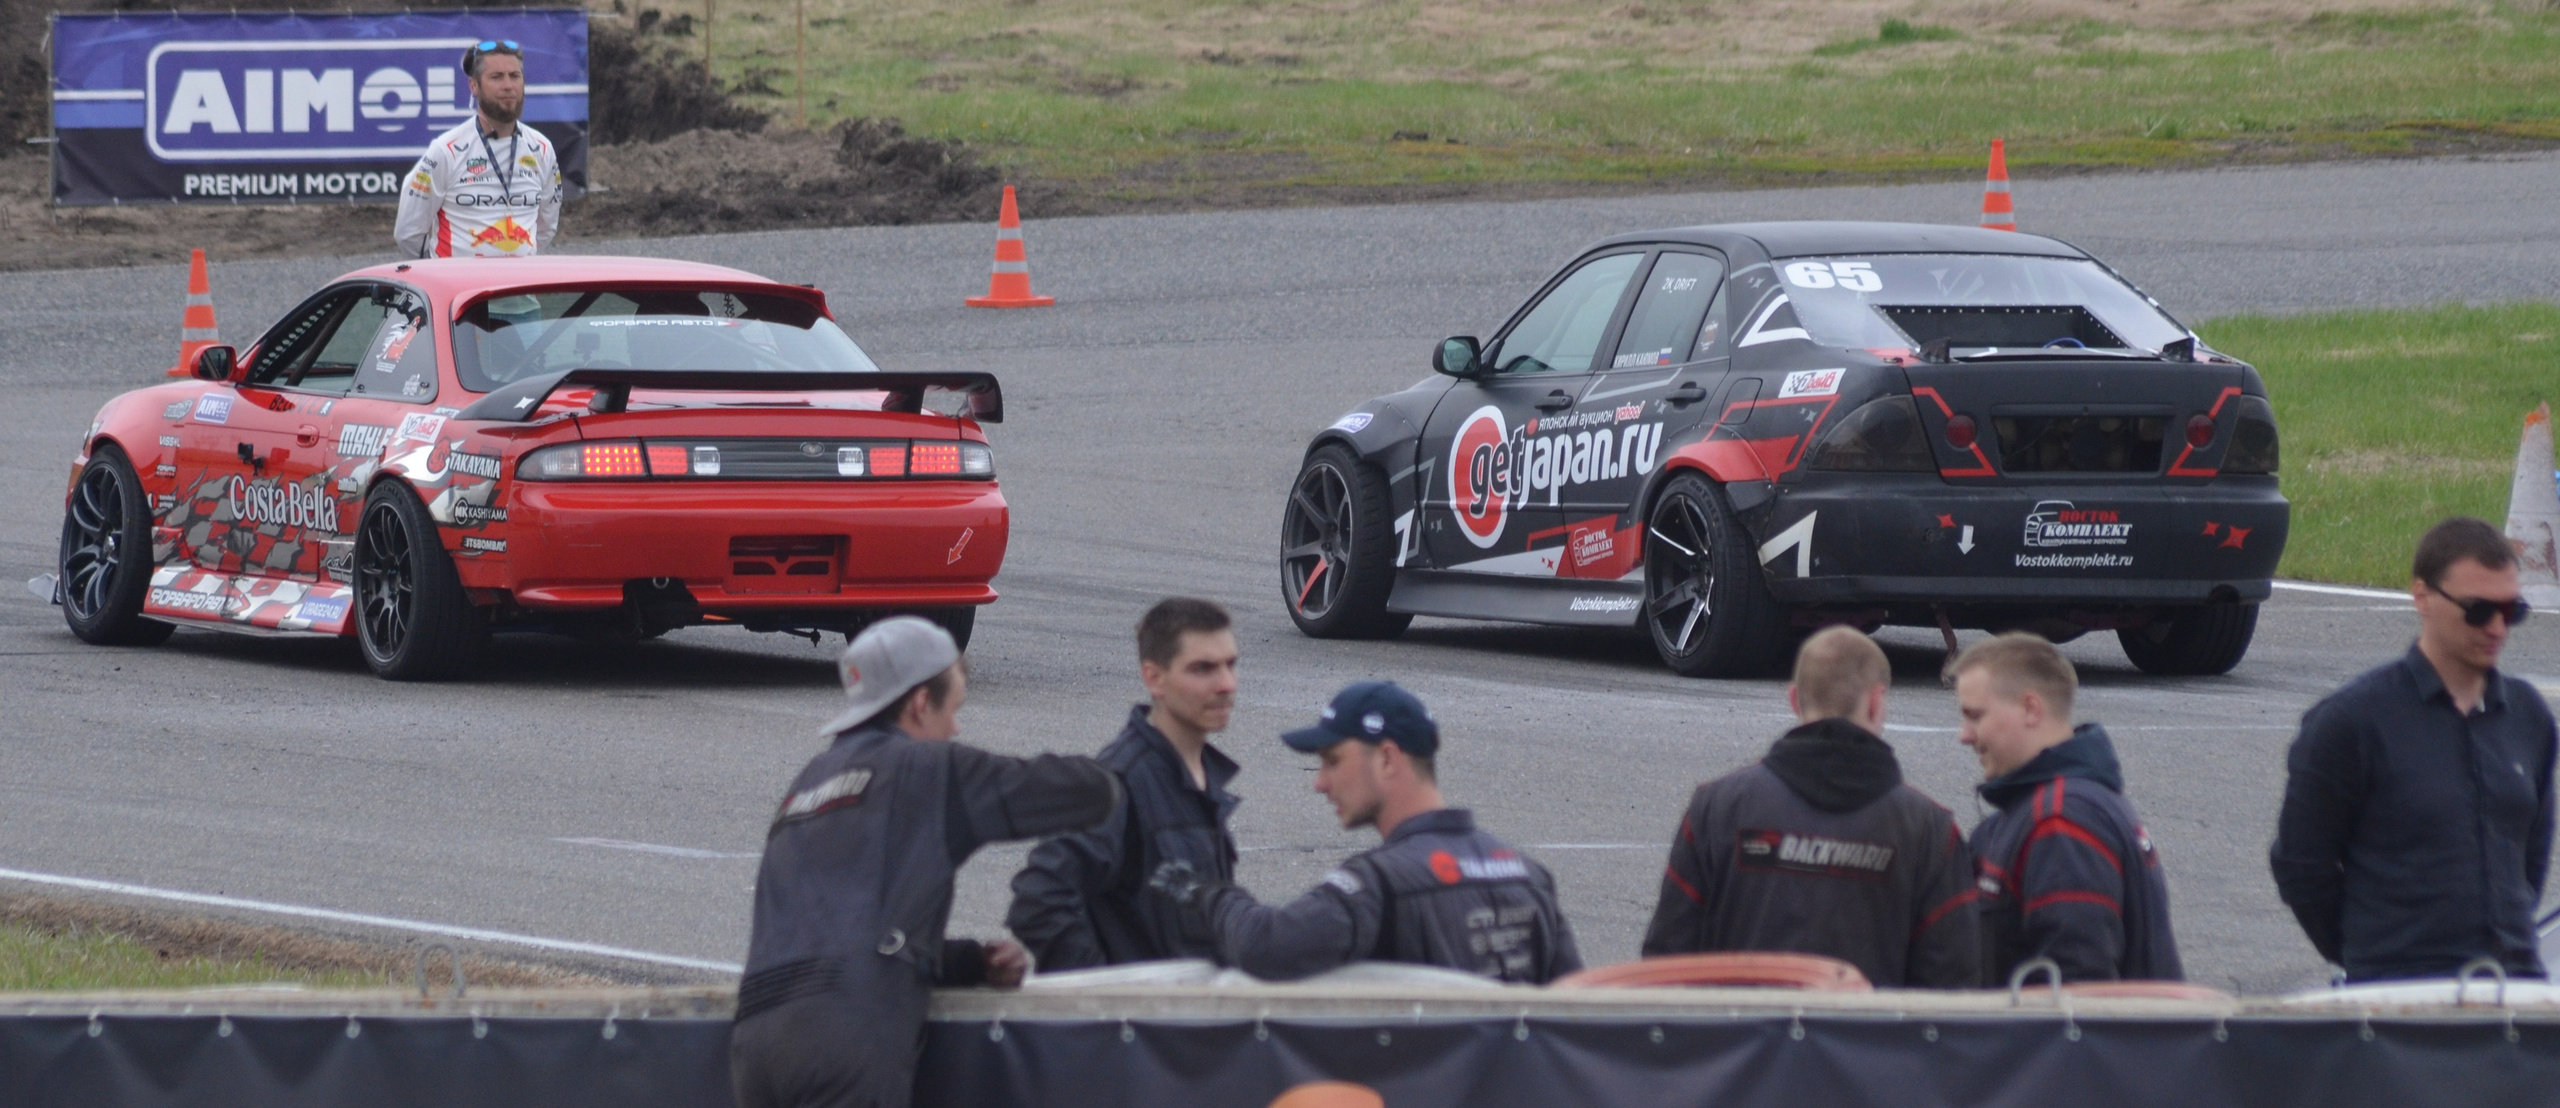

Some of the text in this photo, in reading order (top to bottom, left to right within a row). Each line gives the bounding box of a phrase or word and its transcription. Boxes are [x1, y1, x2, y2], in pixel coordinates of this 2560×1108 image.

[163, 67, 475, 137] AIMOL
[184, 173, 299, 196] PREMIUM
[304, 172, 399, 195] MOTOR
[455, 193, 541, 207] ORACLE
[1784, 261, 1883, 292] 65
[589, 319, 669, 327] ФОРВАРД
[1538, 401, 1646, 431] японский аукцион yahoo!
[449, 452, 501, 479] TAKAYAMA
[1469, 418, 1664, 519] getjapan.ru
[230, 474, 339, 532] Costa Bella
[467, 507, 508, 520] KASHIYAMA
[2059, 510, 2119, 523] ВОСТОК
[2044, 523, 2133, 537] КОМПЛЕКТ
[2015, 553, 2134, 569] Vostokkomplekt.ru
[151, 588, 206, 610] ФОРВАРД
[1779, 834, 1894, 871] BACKWARD
